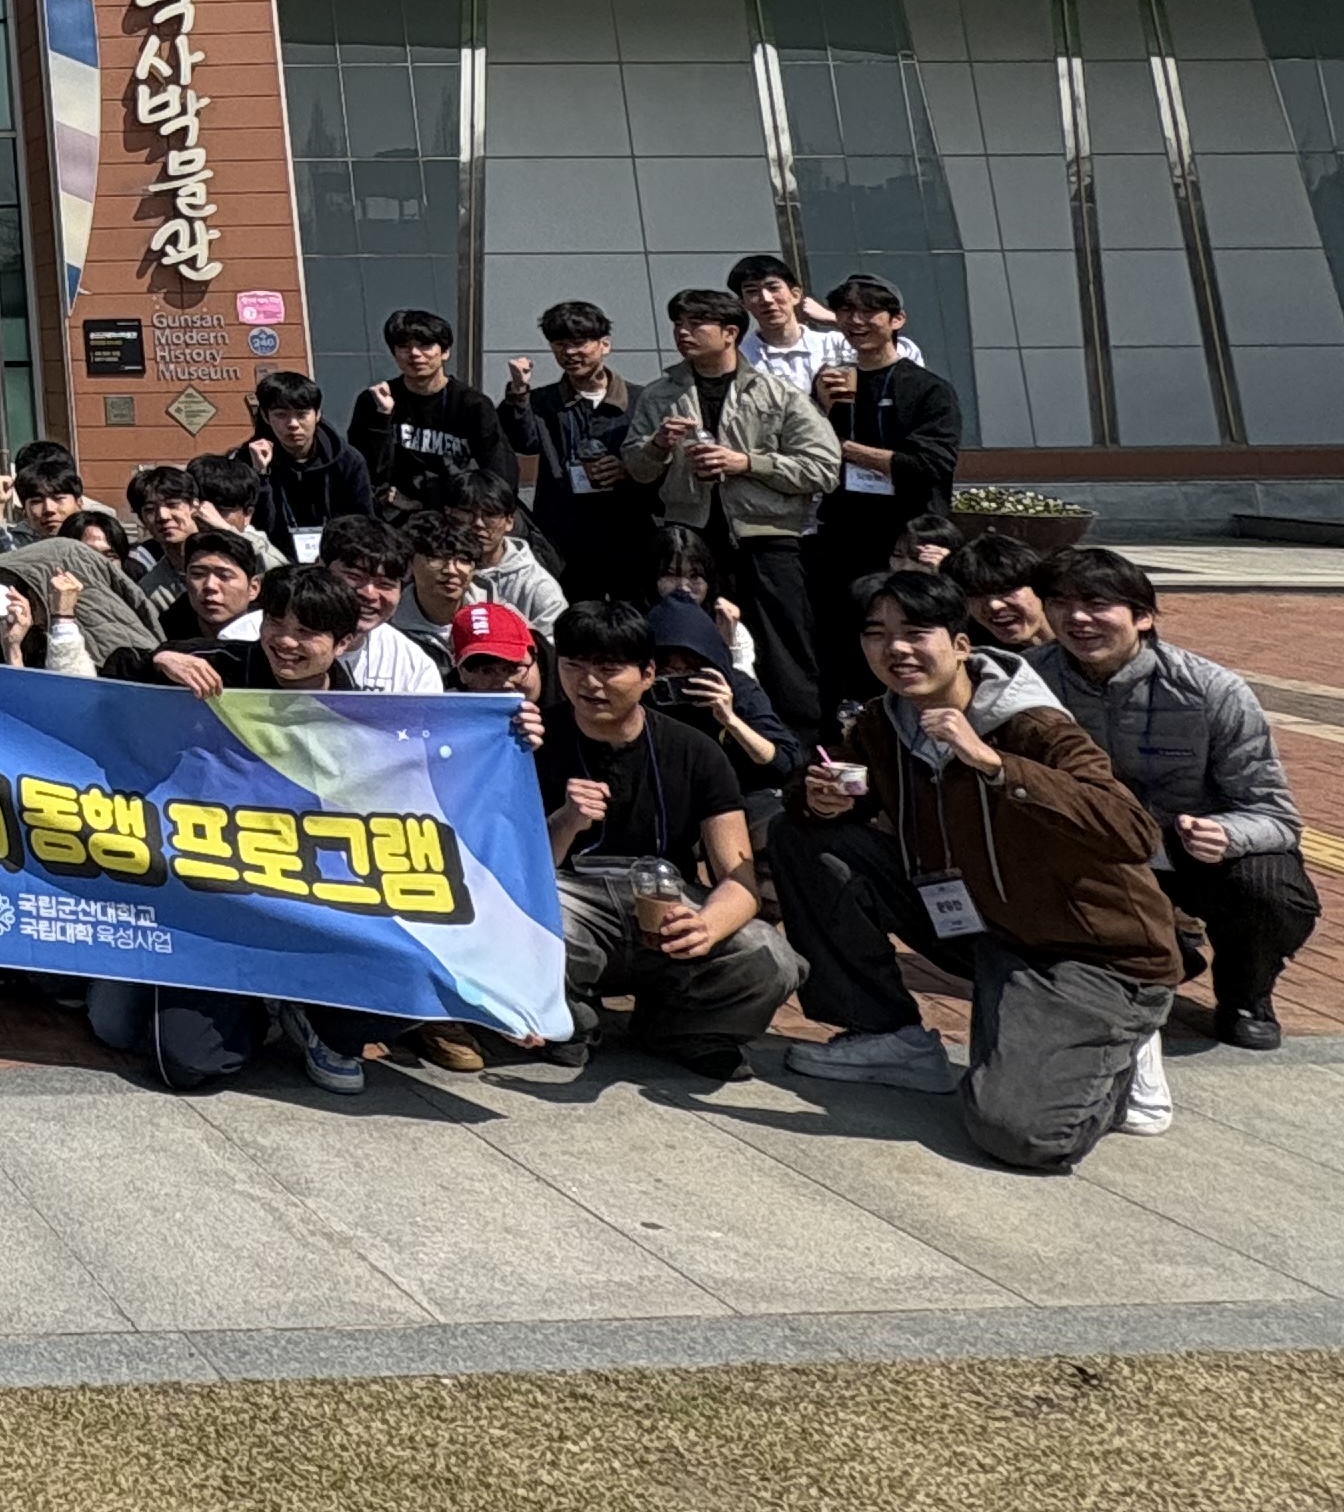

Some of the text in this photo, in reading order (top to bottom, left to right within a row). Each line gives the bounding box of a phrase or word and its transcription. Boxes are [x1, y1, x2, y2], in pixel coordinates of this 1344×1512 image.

[152, 312, 225, 328] Gunsan
[154, 329, 229, 345] Modern
[155, 346, 223, 365] History
[158, 363, 240, 381] Museum
[20, 776, 151, 875] 동행
[169, 802, 455, 912] 프로그램
[17, 893, 159, 928] 국립군산대학교
[20, 918, 173, 954] 국립대학 육성사업
